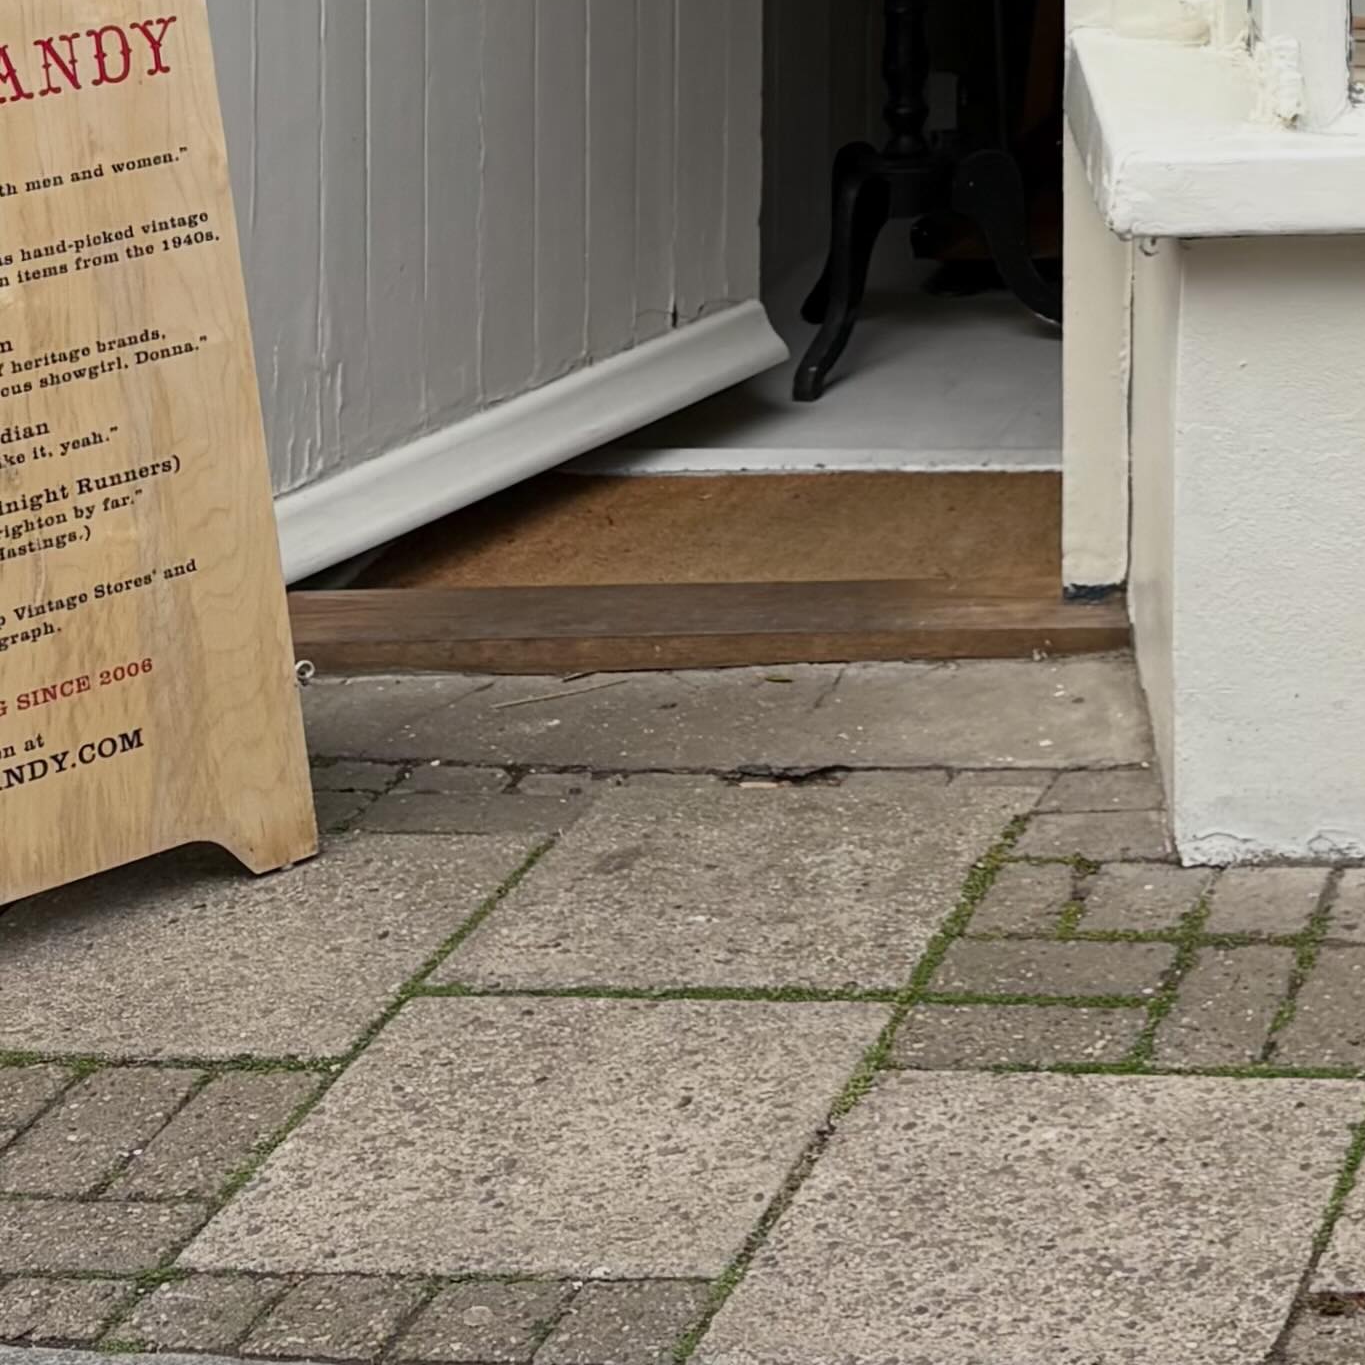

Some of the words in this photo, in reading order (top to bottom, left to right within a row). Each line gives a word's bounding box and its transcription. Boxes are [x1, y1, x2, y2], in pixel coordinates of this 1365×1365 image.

[25, 177, 64, 193] men
[70, 164, 104, 183] and
[20, 225, 135, 262] hand-picked
[141, 211, 208, 236] vintage
[17, 262, 68, 284] items
[75, 251, 119, 271] from
[126, 243, 155, 260] the
[11, 344, 90, 375] heritage
[76, 455, 181, 496] Runners)
[73, 504, 96, 525] by
[13, 592, 88, 622] Vintage
[163, 559, 197, 580] and
[16, 675, 91, 711] SINCE
[99, 658, 153, 687] 2006
[0, 728, 144, 792] NDY.COM
[24, 733, 45, 752] at
